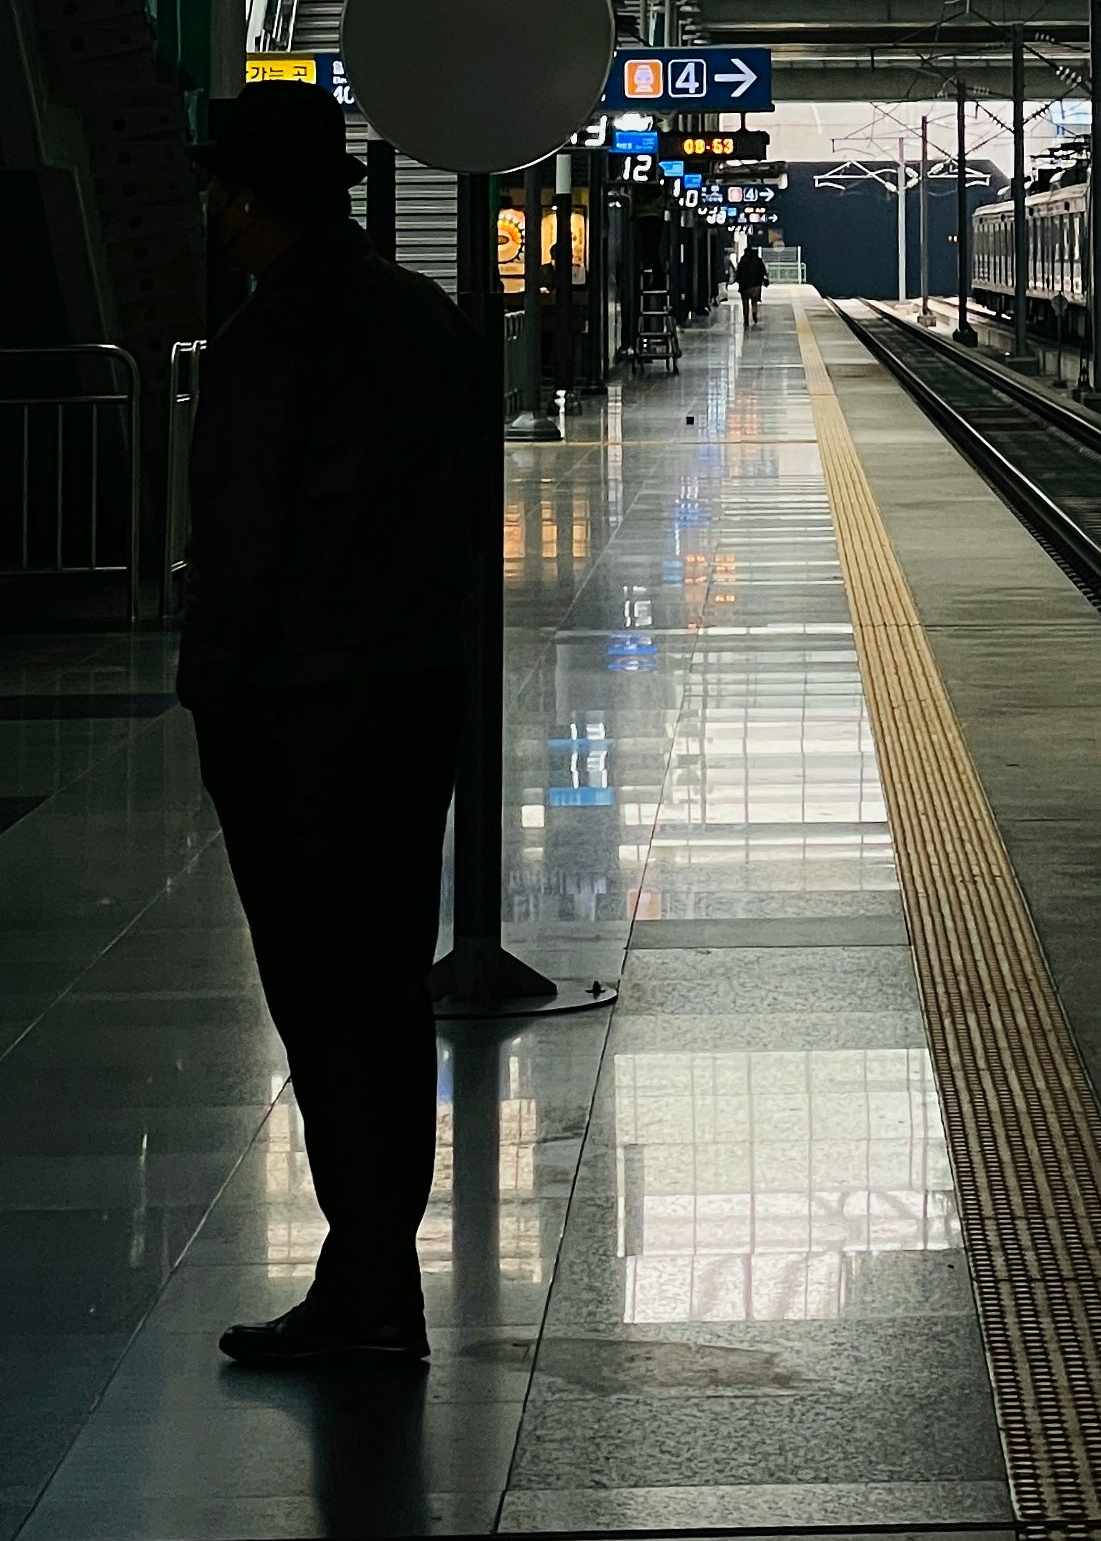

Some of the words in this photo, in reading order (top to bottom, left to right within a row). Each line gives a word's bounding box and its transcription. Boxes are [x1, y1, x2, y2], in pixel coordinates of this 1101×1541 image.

[246, 66, 283, 79] 가는
[675, 62, 699, 94] 4
[623, 154, 652, 182] 12
